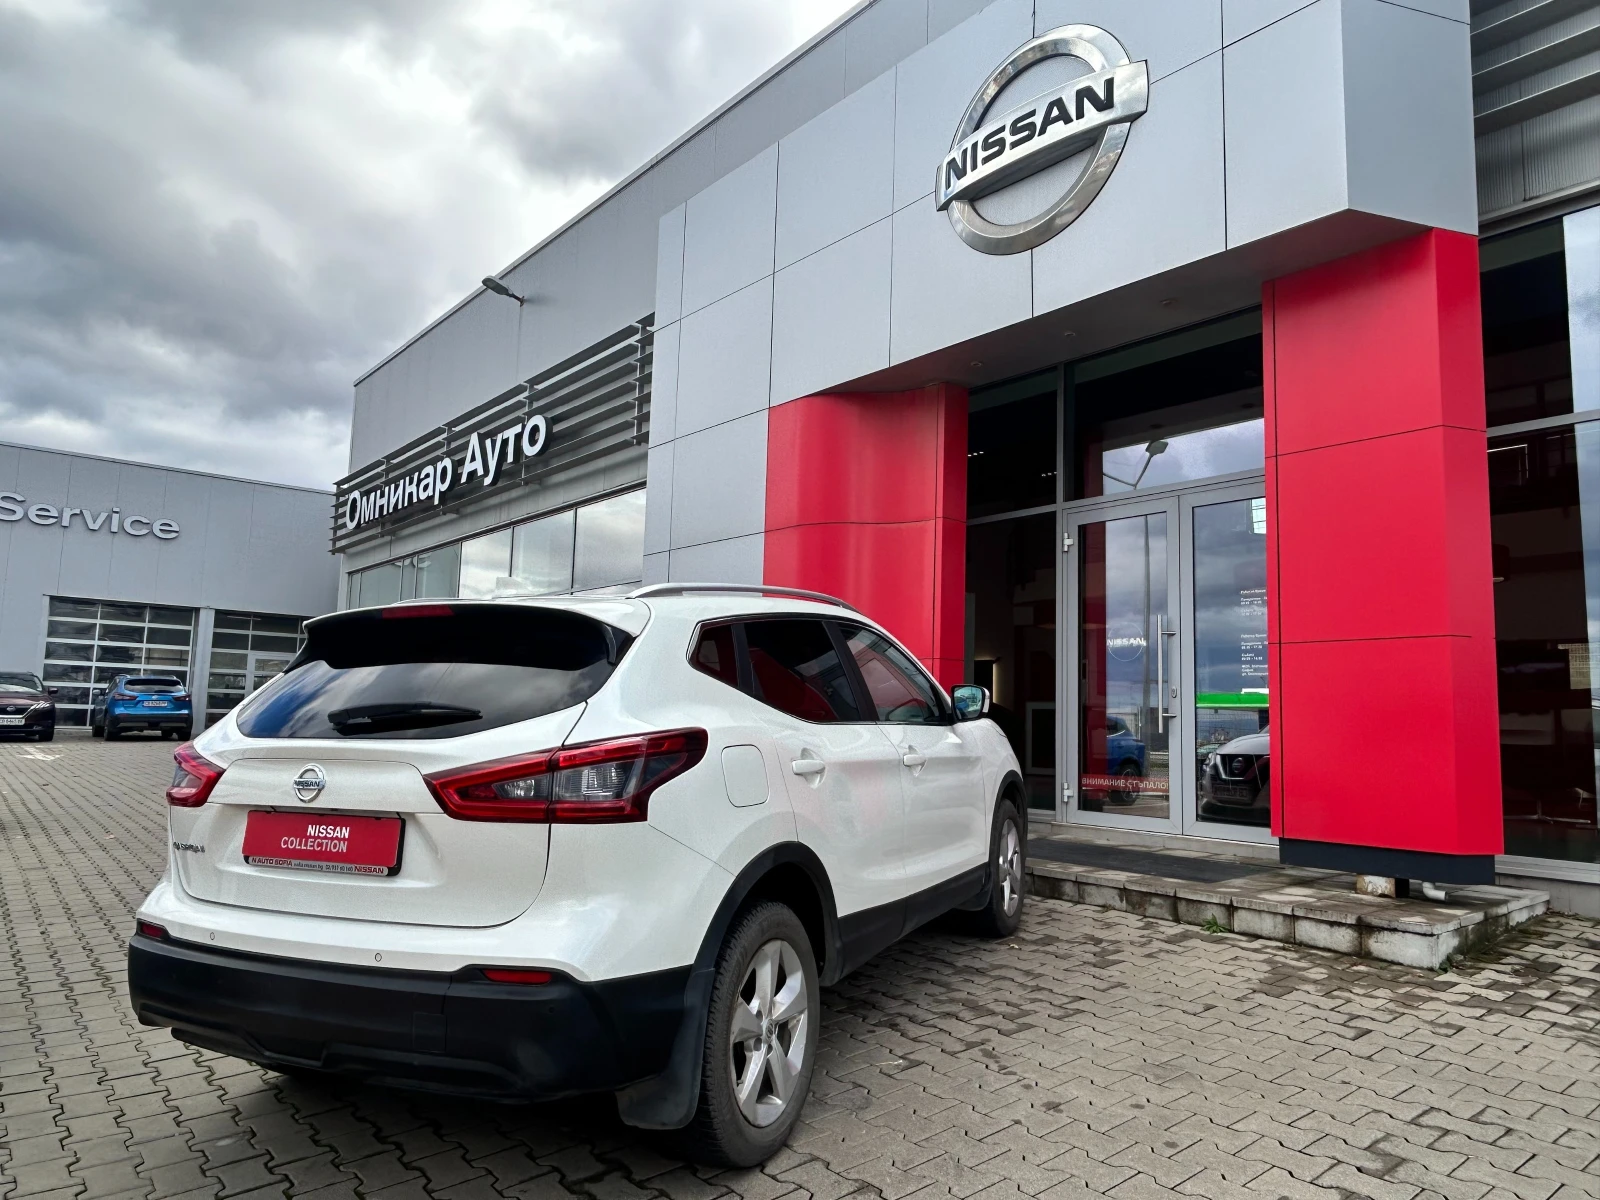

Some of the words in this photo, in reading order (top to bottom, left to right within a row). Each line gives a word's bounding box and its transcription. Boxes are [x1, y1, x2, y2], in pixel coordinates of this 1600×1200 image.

[945, 76, 1115, 191] NISSAN
[345, 457, 453, 530] Омникар
[460, 414, 547, 486] Ауто
[0, 491, 181, 539] Service
[1081, 777, 1126, 787] ВНИМАНИЕ
[307, 824, 350, 839] NISSAN
[280, 836, 348, 853] COLLECTION
[354, 865, 384, 874] NISSAN
